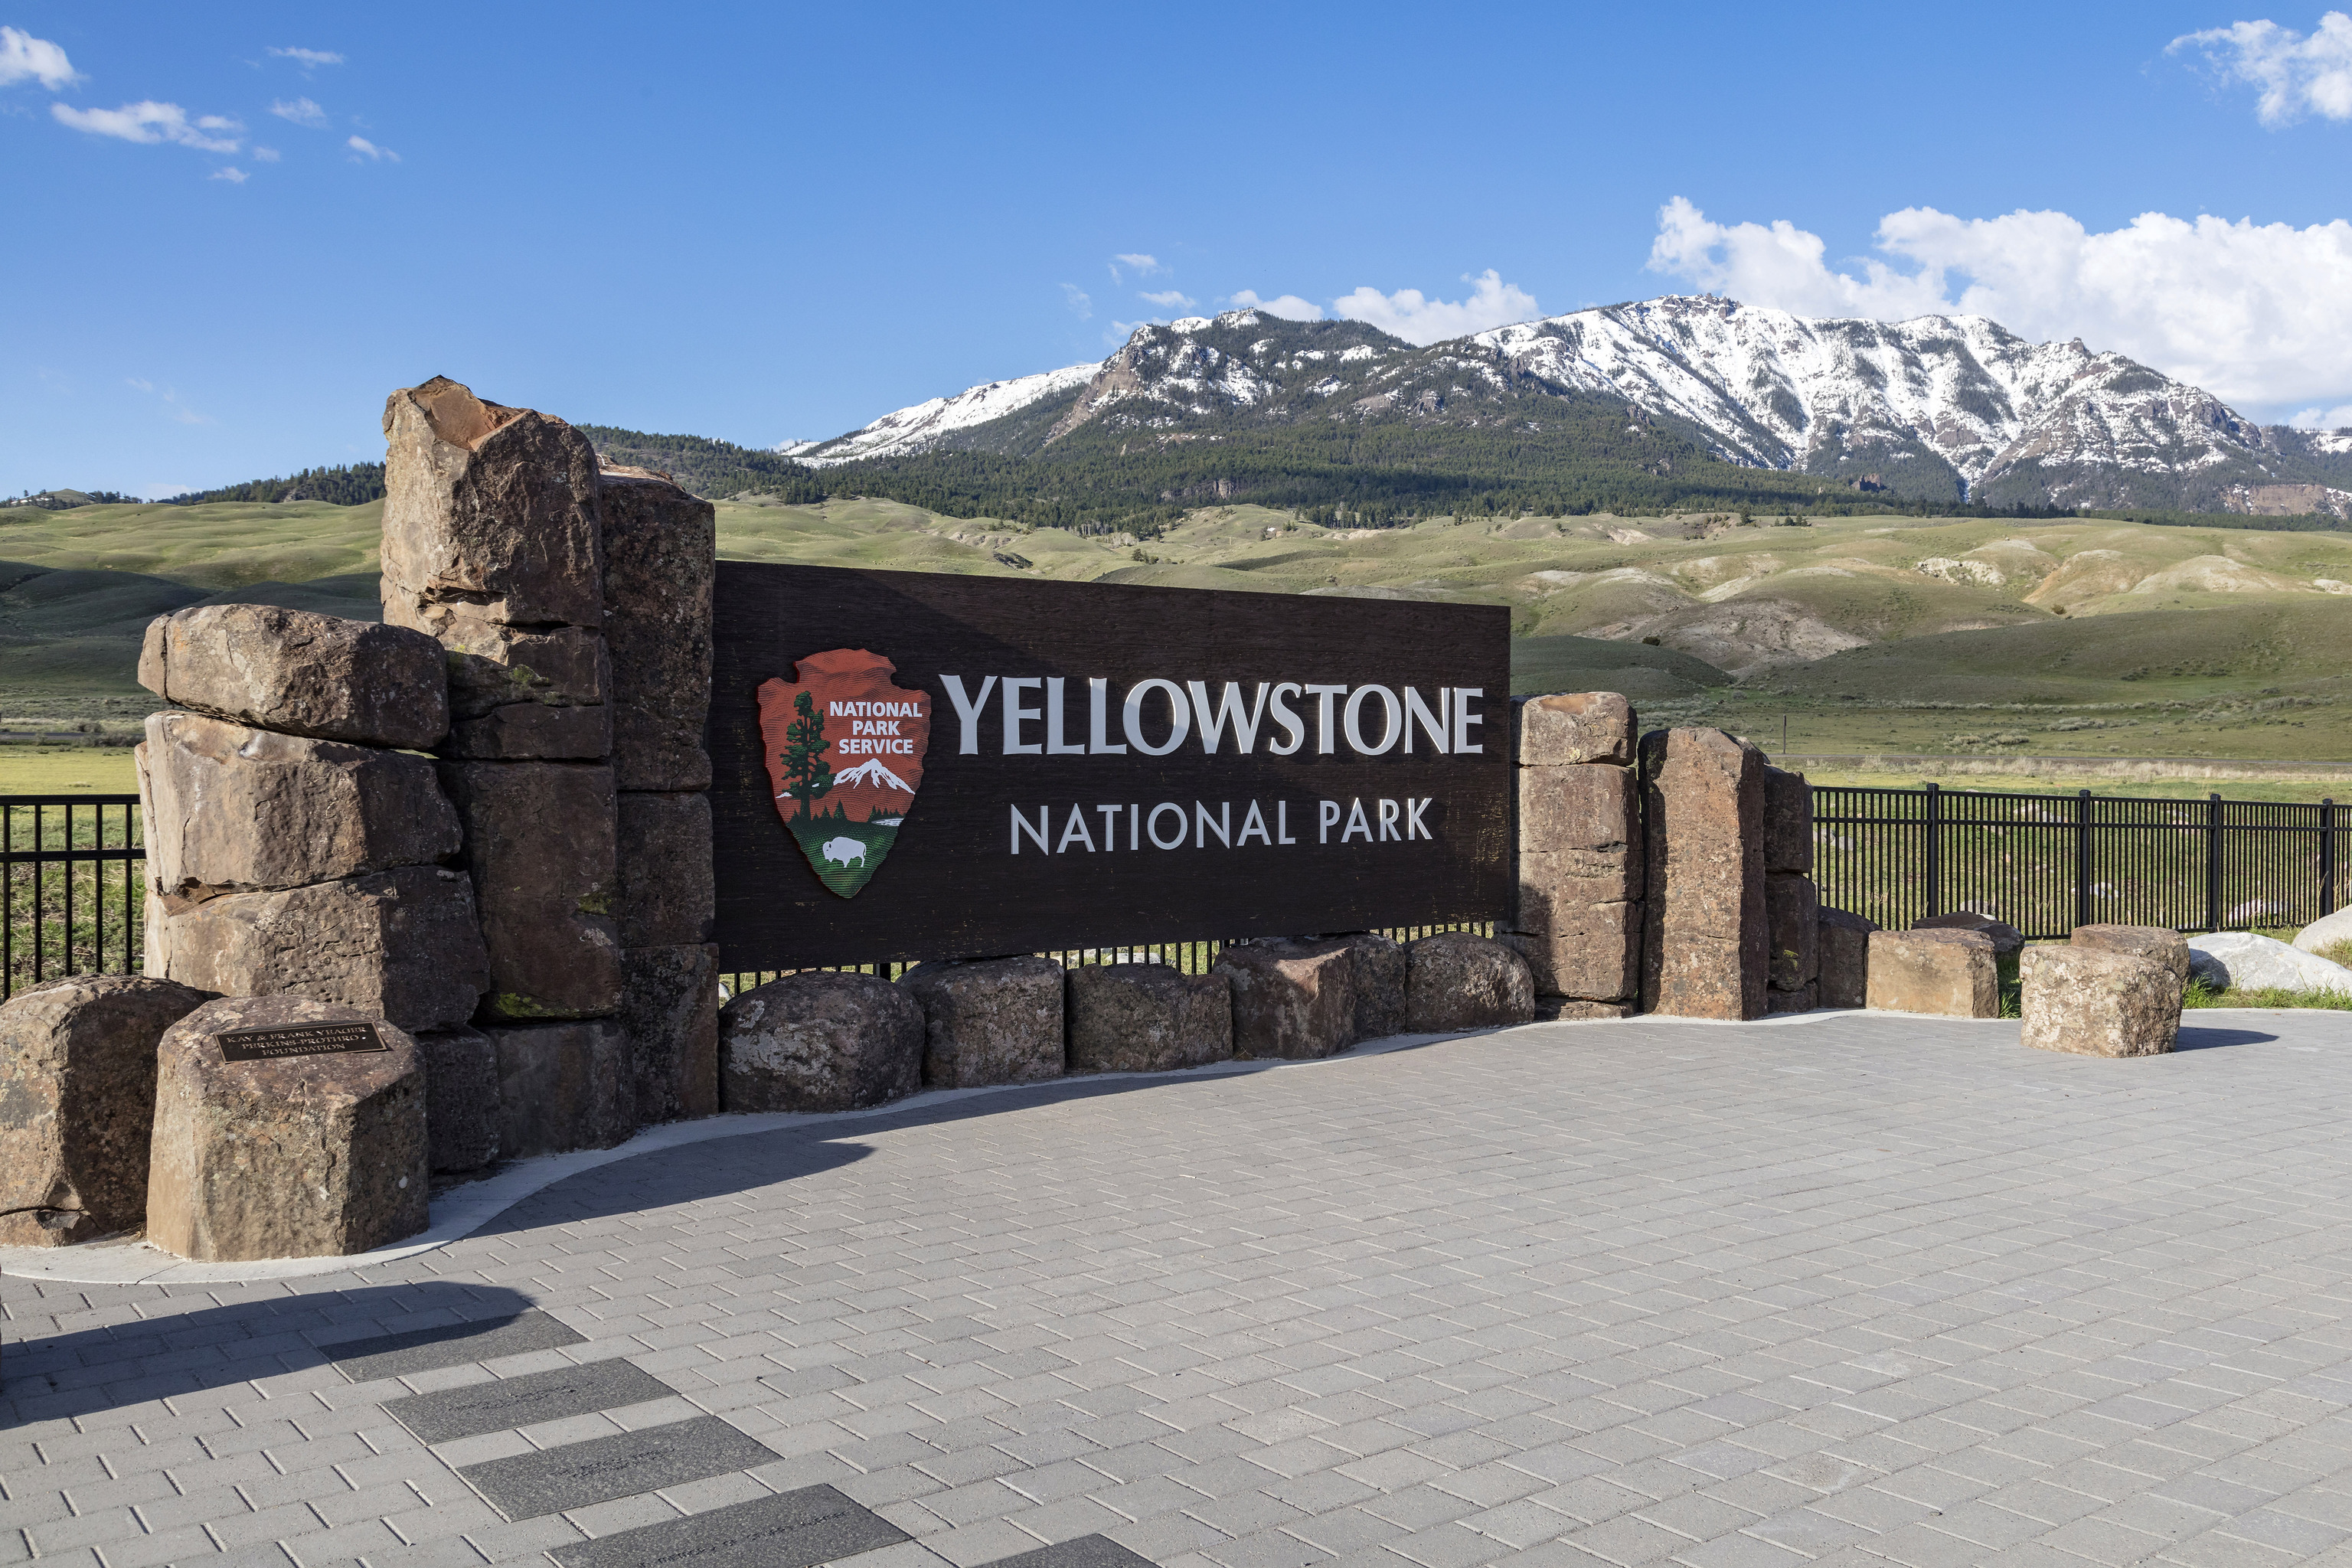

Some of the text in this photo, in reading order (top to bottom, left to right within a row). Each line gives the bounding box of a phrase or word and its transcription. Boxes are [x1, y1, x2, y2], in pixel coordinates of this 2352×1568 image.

[830, 701, 923, 717] NATIONAL
[939, 675, 1484, 756] YELLOWSTONE
[852, 720, 900, 736] PARK
[838, 738, 913, 754] SERVICE
[1011, 797, 1433, 856] NATIONAL PARK
[227, 1034, 253, 1043] KAY
[270, 1030, 315, 1040] FRANK
[316, 1027, 368, 1036] YEAGER
[242, 1034, 360, 1050] PERKINS-PROTHRO
[263, 1043, 346, 1056] FOUNDATION
